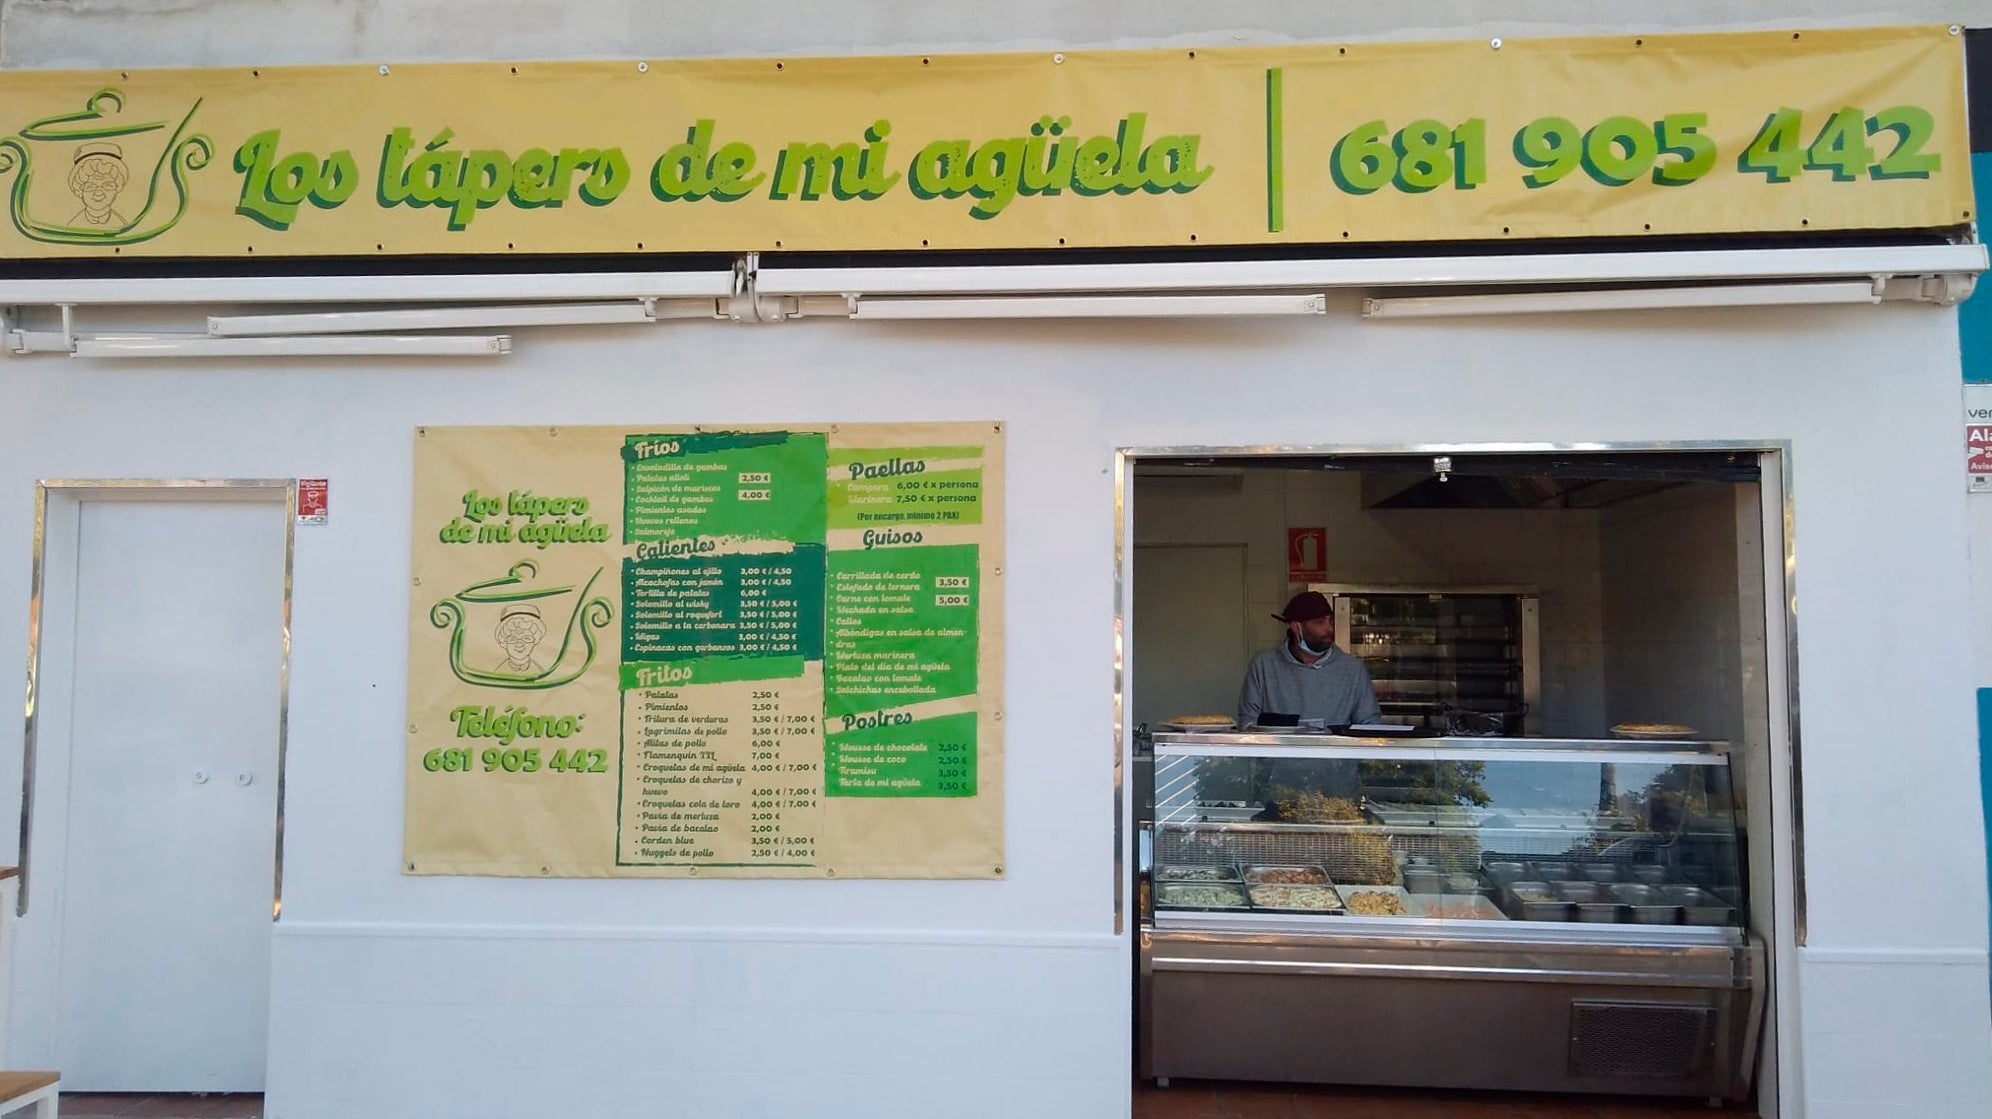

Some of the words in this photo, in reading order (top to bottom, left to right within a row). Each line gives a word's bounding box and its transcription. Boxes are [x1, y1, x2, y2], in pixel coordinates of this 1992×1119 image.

[1329, 117, 1486, 195] 681
[1512, 112, 1717, 190] 905
[1737, 105, 1942, 184] 442
[234, 128, 360, 231] Los
[376, 126, 631, 231] tápers
[649, 118, 767, 203] de
[768, 118, 901, 202] mi
[907, 112, 1216, 221] agüela
[635, 441, 680, 458] Fríos
[849, 458, 925, 481] Paellas
[897, 482, 920, 490] 6,00
[940, 481, 979, 490] persona
[937, 495, 976, 503] persona
[462, 490, 502, 522] Los
[508, 490, 589, 522] tápers
[857, 512, 872, 521] (Por
[440, 517, 475, 543] de
[477, 519, 516, 543] mi
[518, 516, 612, 550] agüela
[863, 529, 923, 550] Guisos
[637, 539, 715, 559] Calientes
[636, 568, 690, 576] Champiñones
[703, 568, 722, 576] ajillo
[741, 568, 759, 576] 3,00
[773, 568, 792, 576] 4,50
[698, 579, 723, 587] jamón
[679, 590, 710, 598] patatas
[740, 611, 757, 619] 3,50
[771, 611, 790, 619] 5,00
[740, 622, 757, 630] 3,50
[771, 622, 790, 630] 5,00
[739, 633, 757, 641] 3,00
[771, 633, 789, 641] 4,50
[740, 644, 757, 652] 3,00
[771, 644, 789, 652] 4,50
[636, 665, 693, 686] Fritos
[752, 716, 771, 724] 3,50
[787, 716, 807, 724] 7,00
[842, 711, 913, 731] Postres
[450, 704, 586, 746] Teléfono:
[644, 727, 691, 737] Lagrimitas
[705, 727, 727, 737] pollo
[752, 728, 771, 736] 3,50
[644, 740, 669, 748] Alitas
[684, 740, 706, 749] pollo
[752, 740, 772, 748] 6,00
[424, 748, 473, 772] 681
[482, 748, 542, 773] 905
[550, 748, 609, 773] 442
[643, 763, 686, 773] Croquetas
[716, 764, 745, 773] agüela
[751, 764, 773, 772] 4,00
[642, 776, 686, 785] Croquetas
[689, 776, 700, 784] de
[702, 776, 734, 784] chorizo
[736, 777, 742, 785] y
[642, 788, 668, 796] huevo
[642, 800, 686, 810] Croquetas
[722, 801, 740, 809] toro
[789, 800, 809, 808] 7,00
[684, 825, 718, 833] bacalao
[751, 825, 772, 833] 2,00
[675, 837, 694, 845] blue
[751, 837, 770, 845] 3,50
[787, 837, 807, 845] 5,00
[641, 849, 676, 859] Nuggets
[679, 849, 690, 857] de
[692, 849, 714, 858] pollo
[751, 849, 770, 857] 2,50
[787, 849, 807, 857] 4,00
